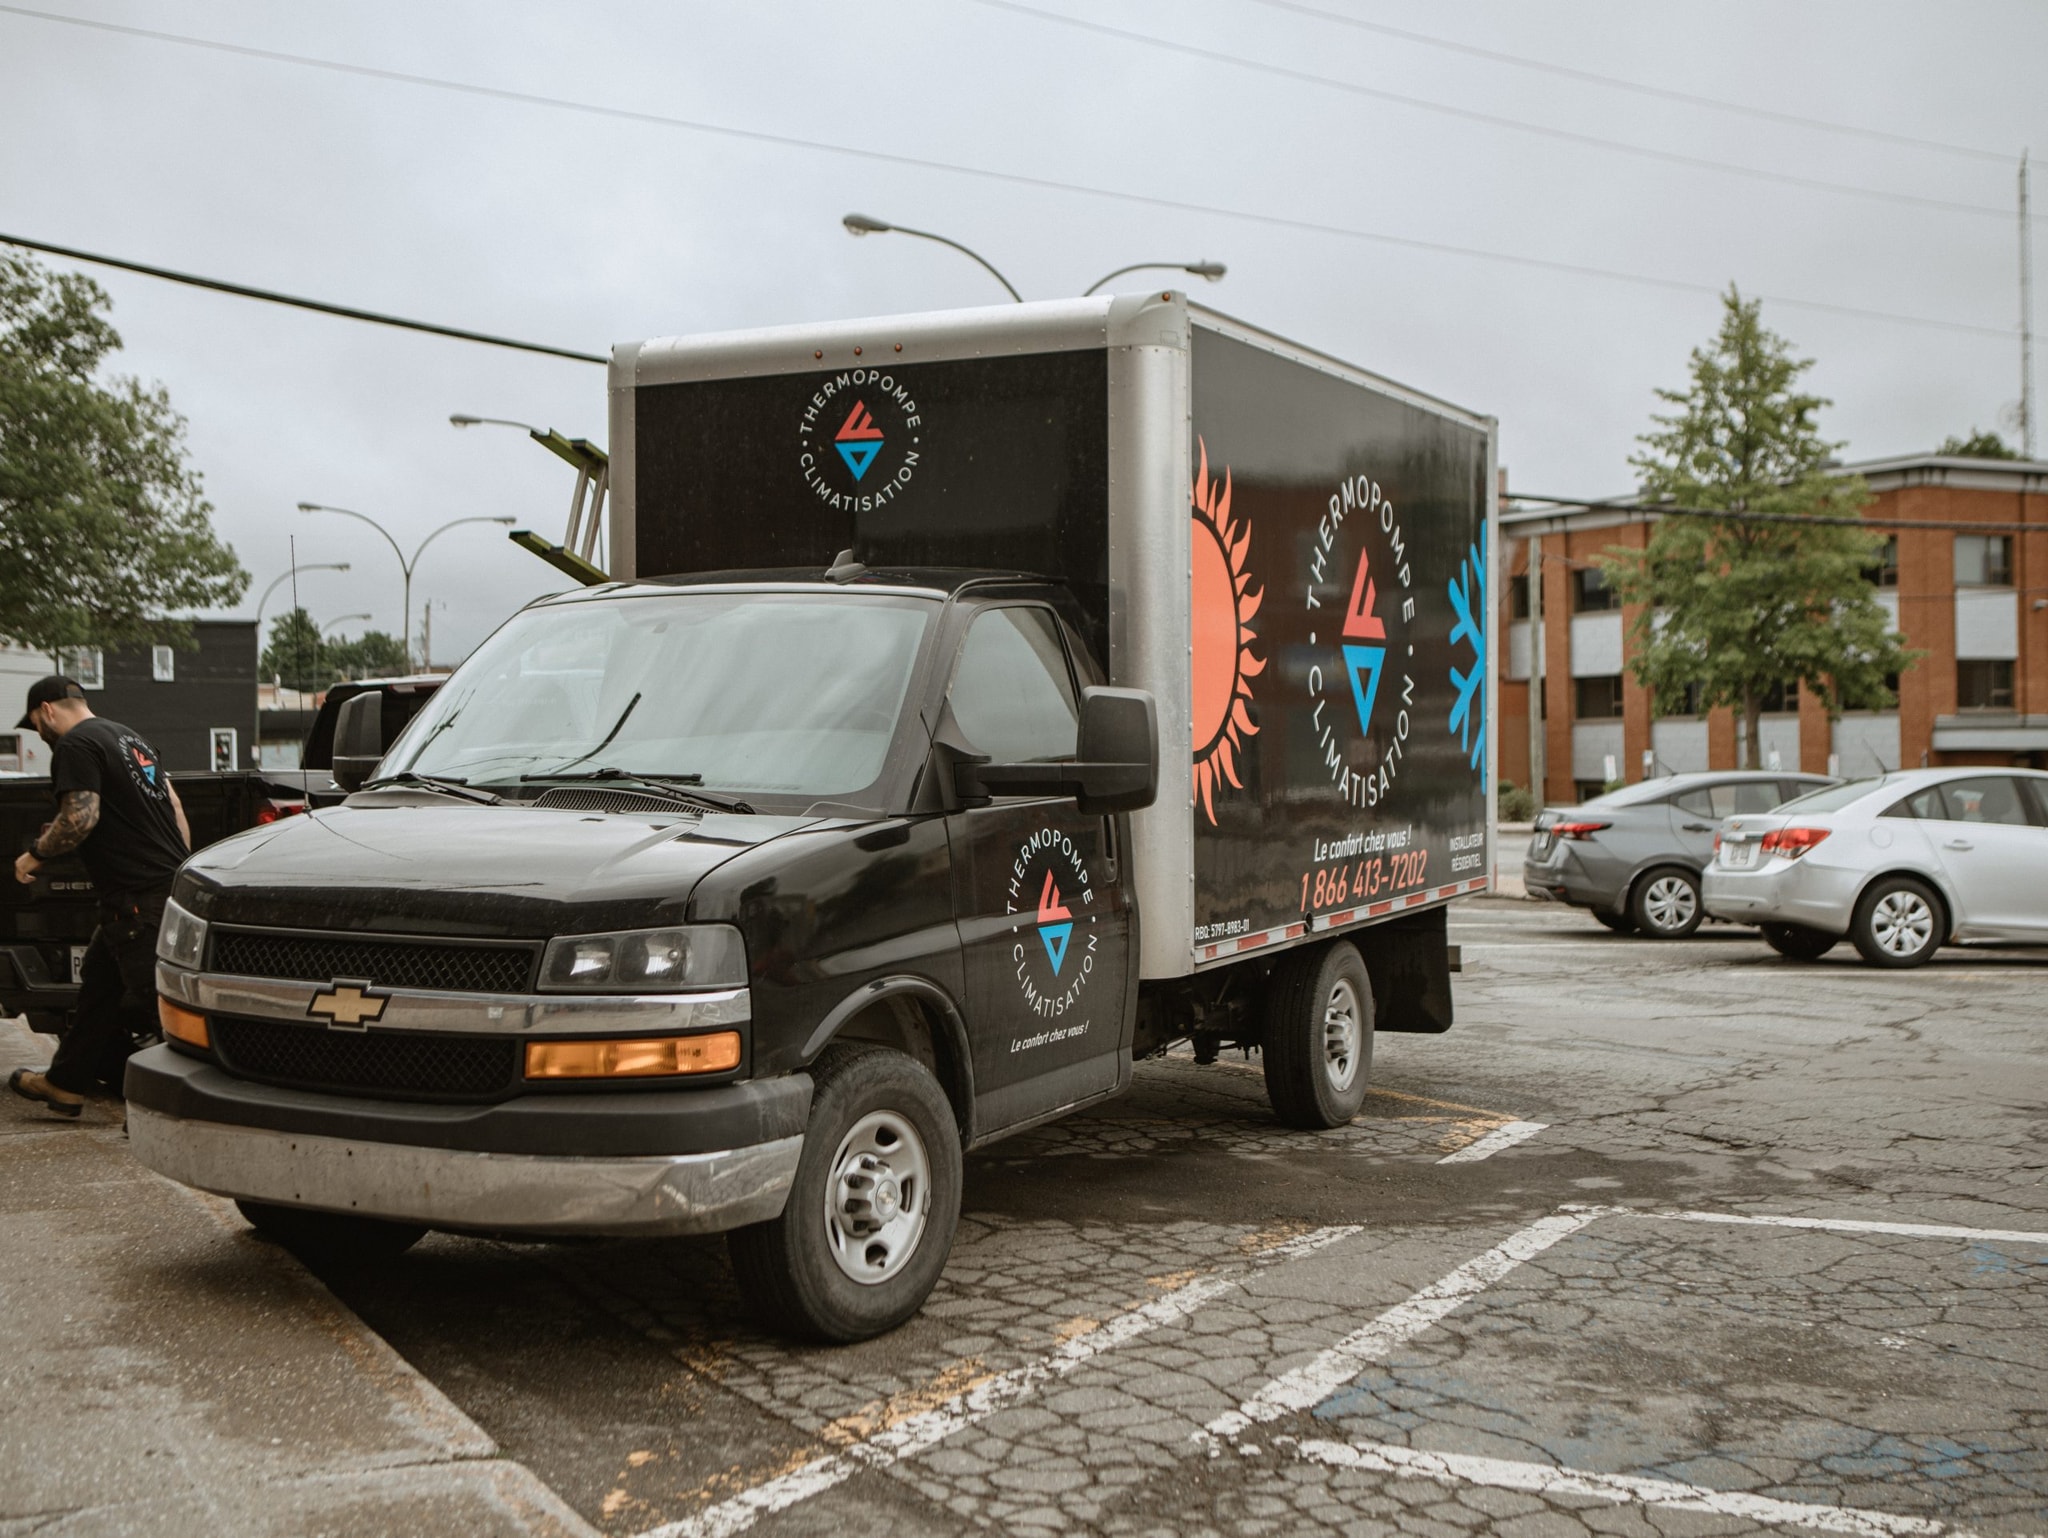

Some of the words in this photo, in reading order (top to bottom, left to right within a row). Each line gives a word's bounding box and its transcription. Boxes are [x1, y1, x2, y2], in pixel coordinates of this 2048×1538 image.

[800, 369, 921, 434] THERMOPOMPE
[800, 450, 920, 512] CLIMATISATION
[1306, 475, 1415, 623] THERMOPOMPE
[1309, 664, 1414, 808] CLIMATISATION
[1007, 828, 1094, 915] THERMOPOMPE
[1314, 838, 1328, 862] Le
[1329, 833, 1363, 860] confort
[1364, 830, 1386, 853] chez
[1300, 872, 1310, 912] 1
[1313, 865, 1348, 909] 866
[1352, 849, 1428, 898] 413-7202
[1013, 933, 1098, 1018] CLIMATISATION
[1010, 1038, 1022, 1053] Le
[1022, 1032, 1049, 1050] confort
[1049, 1028, 1067, 1043] chez
